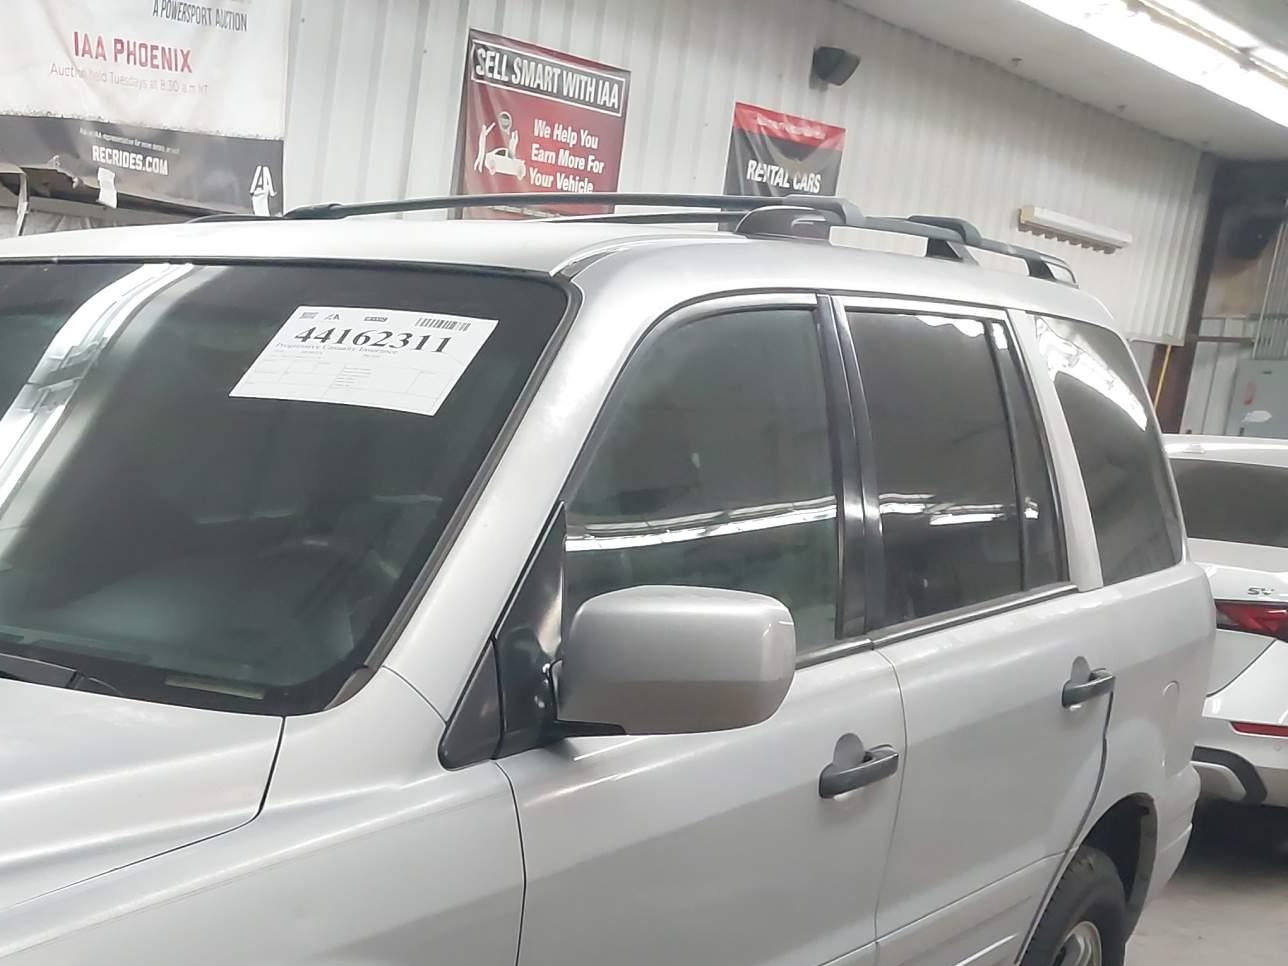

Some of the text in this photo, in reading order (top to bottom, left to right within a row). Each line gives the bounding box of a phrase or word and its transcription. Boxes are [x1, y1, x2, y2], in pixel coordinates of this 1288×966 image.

[153, 0, 248, 32] A POWERSPORT AUCTION
[74, 31, 192, 74] IAA PHOENIX
[476, 48, 619, 109] SELL SMART WITH IAA
[534, 119, 599, 149] We Help You
[92, 145, 168, 175] RECRIDES.COM
[531, 143, 605, 174] Earn More For
[529, 167, 594, 193] Your Vehicle
[746, 160, 822, 193] RENTAL CARS
[294, 326, 452, 354] 44162311
